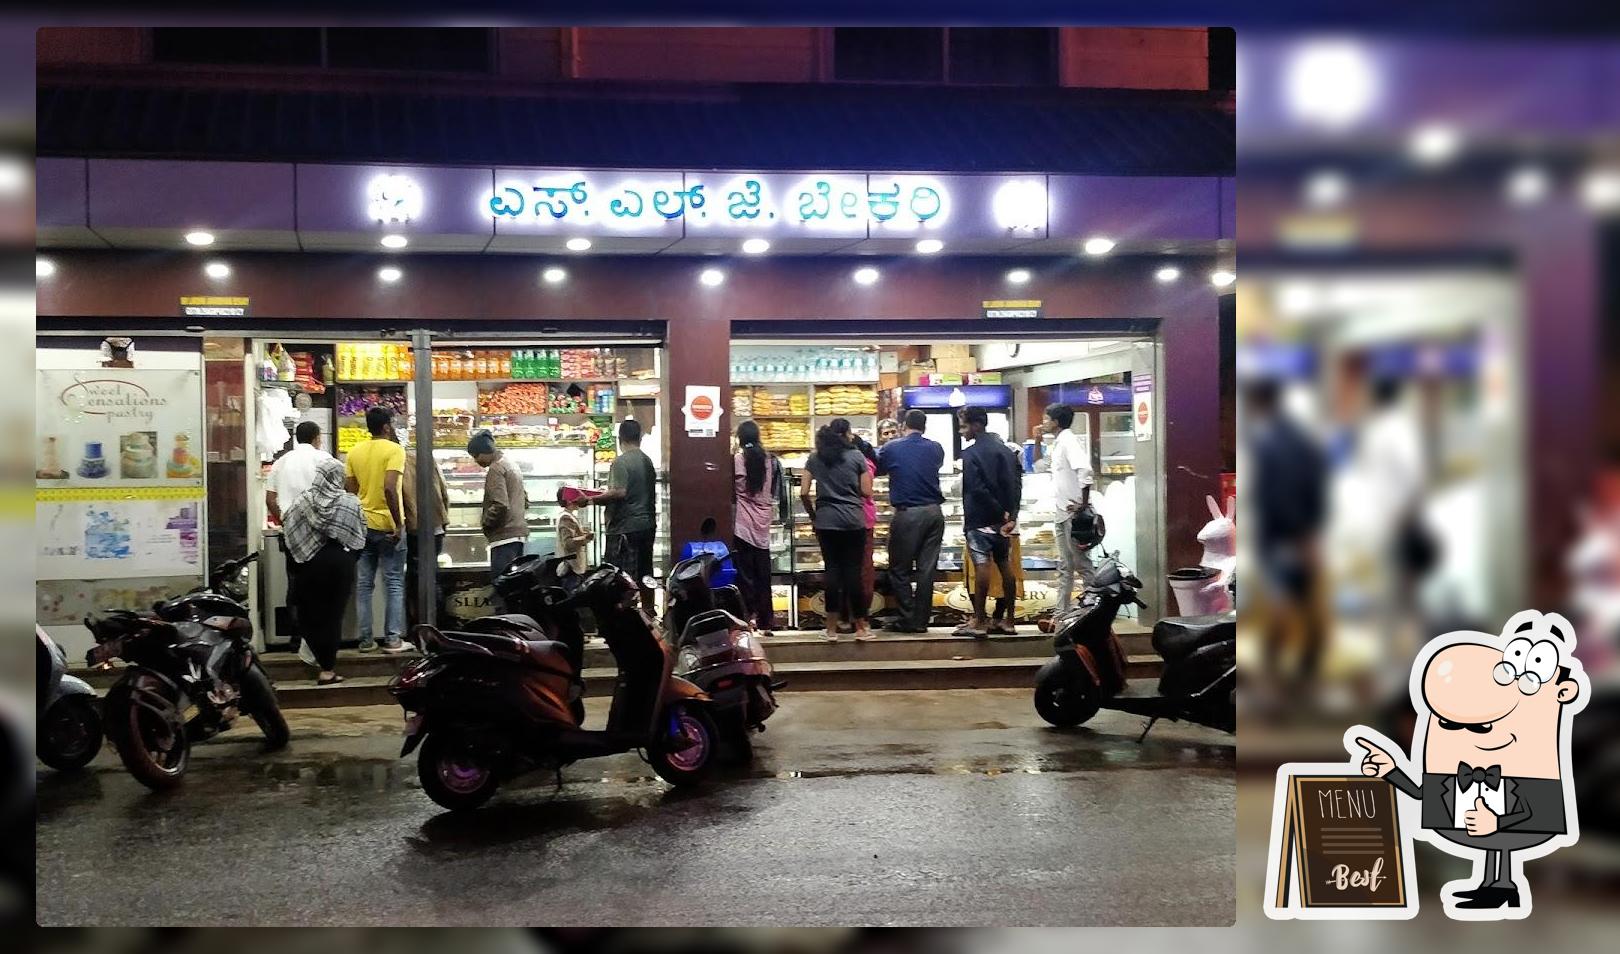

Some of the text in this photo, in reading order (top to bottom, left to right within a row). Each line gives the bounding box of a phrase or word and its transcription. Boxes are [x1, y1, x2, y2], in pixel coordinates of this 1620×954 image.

[490, 181, 588, 218] ಎಸ್.
[610, 185, 706, 220] ಎಲ್.
[799, 181, 941, 221] ಬೇಕರಿ
[106, 407, 154, 424] pastry
